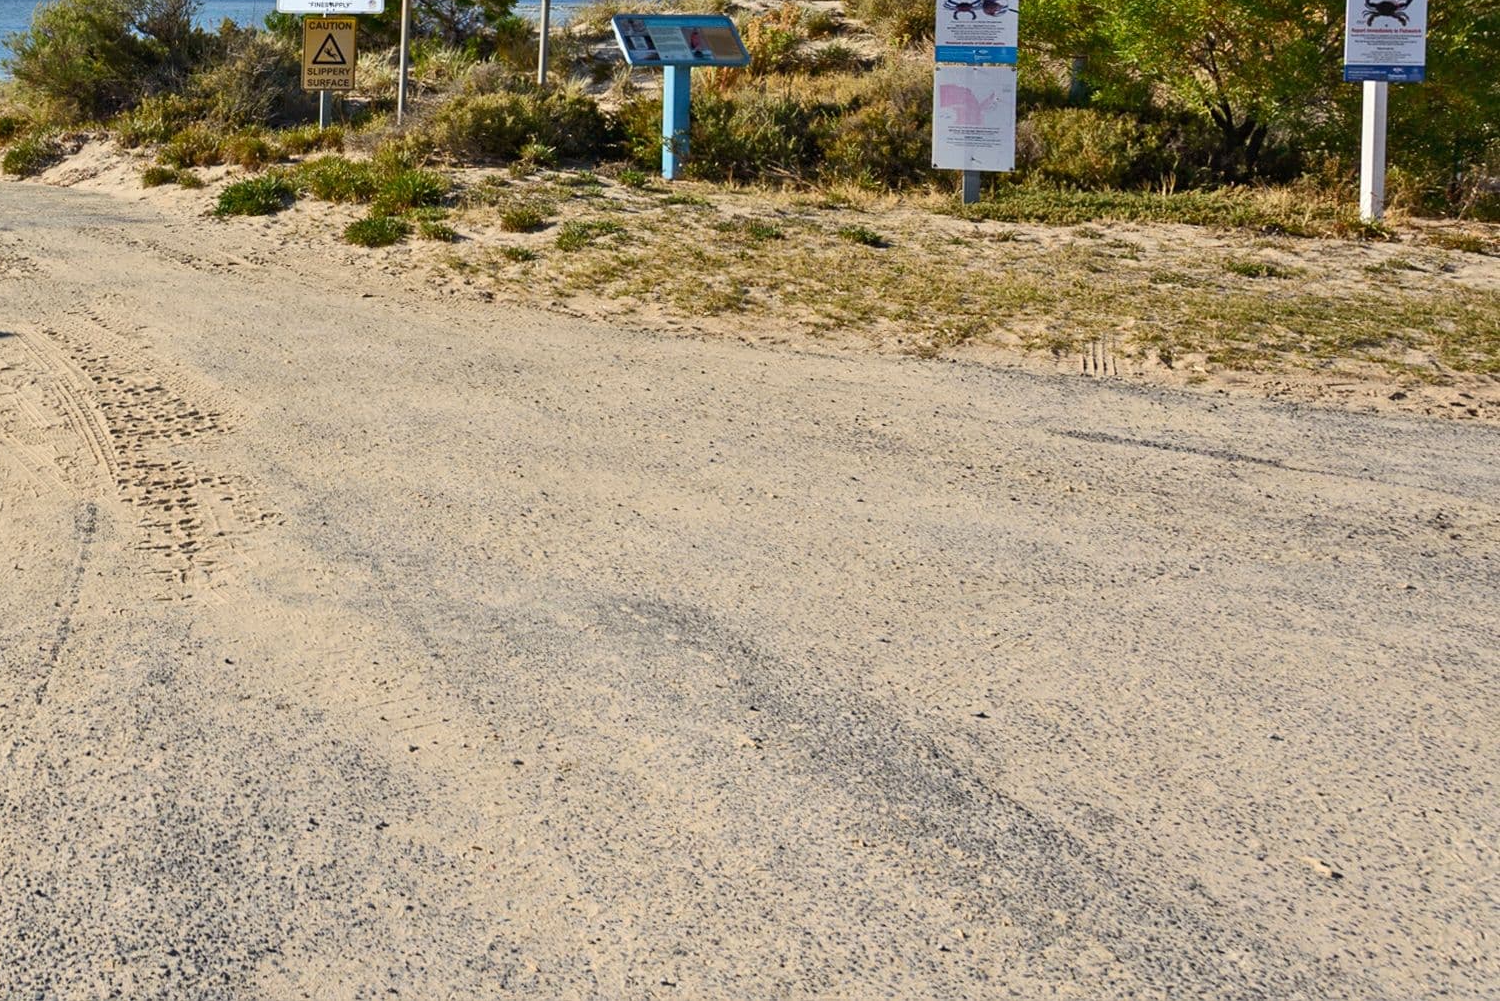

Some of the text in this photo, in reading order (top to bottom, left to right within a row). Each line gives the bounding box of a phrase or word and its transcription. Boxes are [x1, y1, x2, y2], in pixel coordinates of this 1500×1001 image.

[308, 21, 352, 30] CAUTION
[307, 67, 351, 76] SLIPPERY
[307, 78, 350, 87] SURFACE
